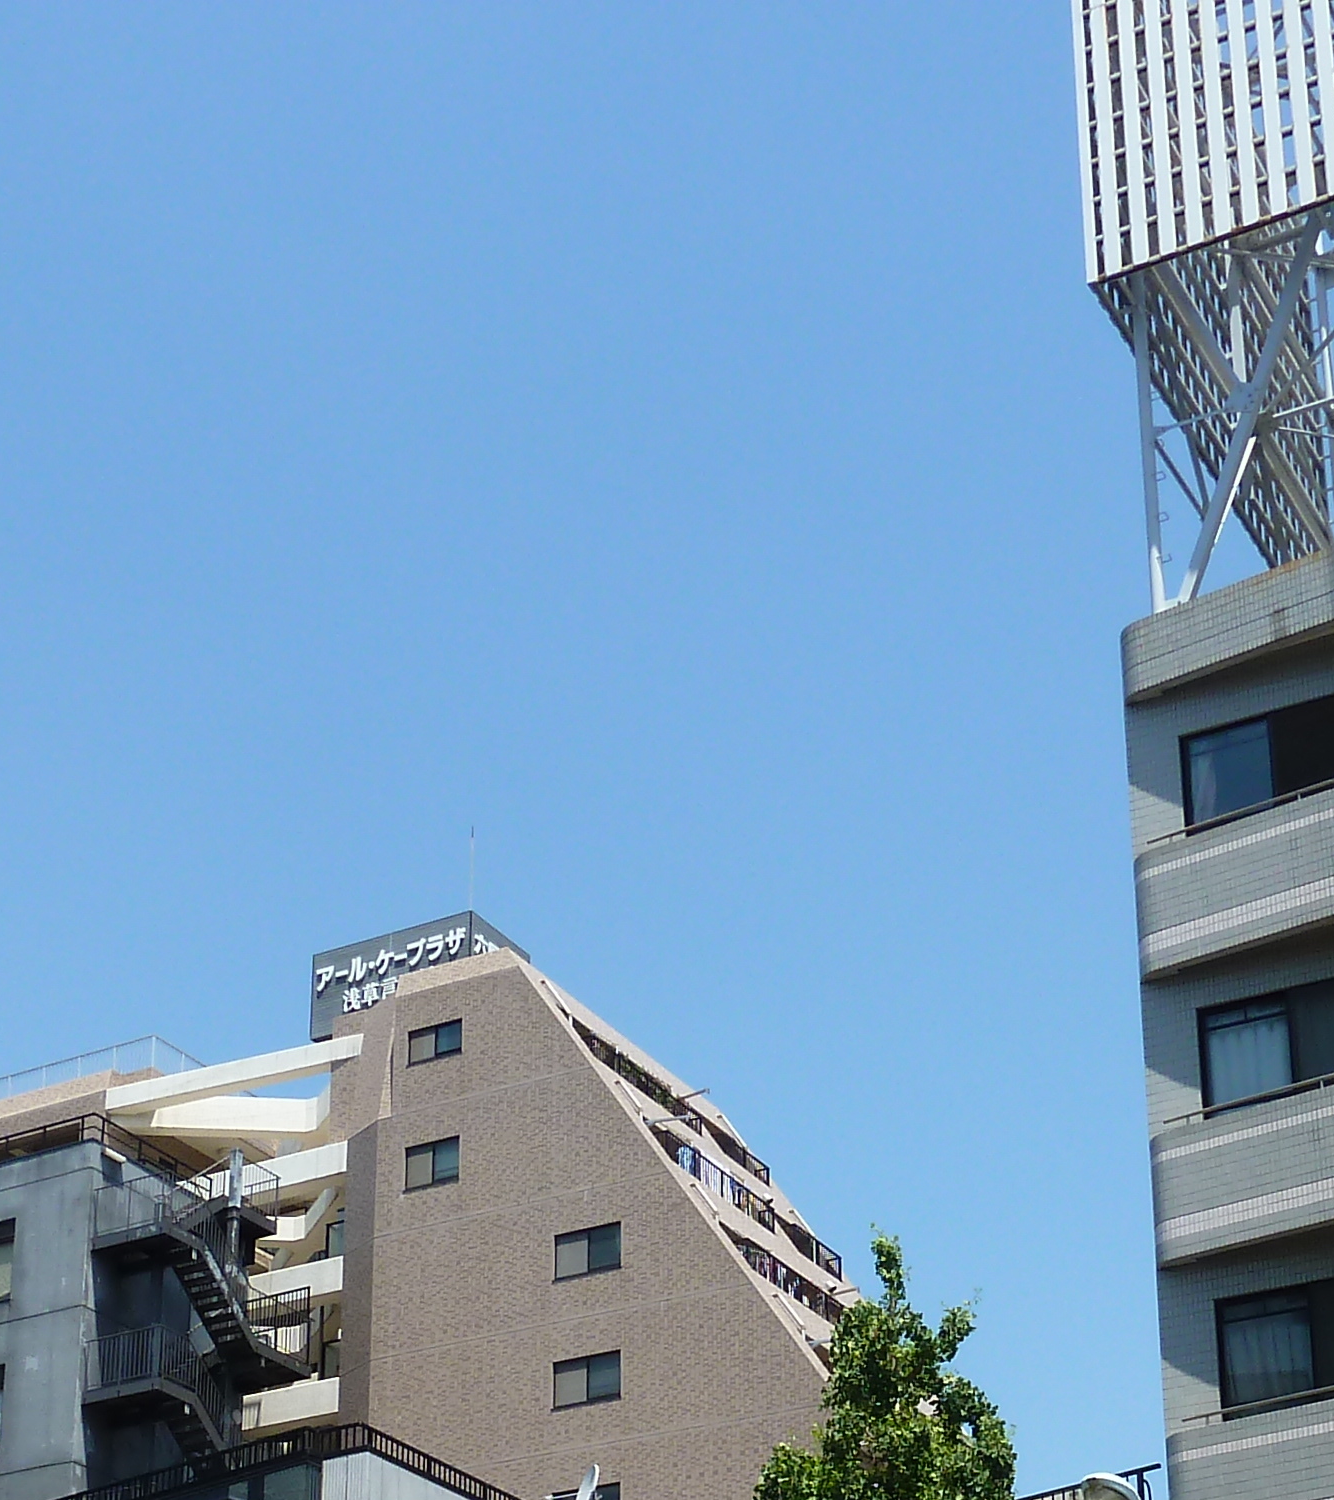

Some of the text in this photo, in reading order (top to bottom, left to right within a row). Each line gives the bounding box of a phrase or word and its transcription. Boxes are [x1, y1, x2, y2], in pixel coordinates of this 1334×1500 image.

[315, 926, 467, 993] アール・ケープラザ
